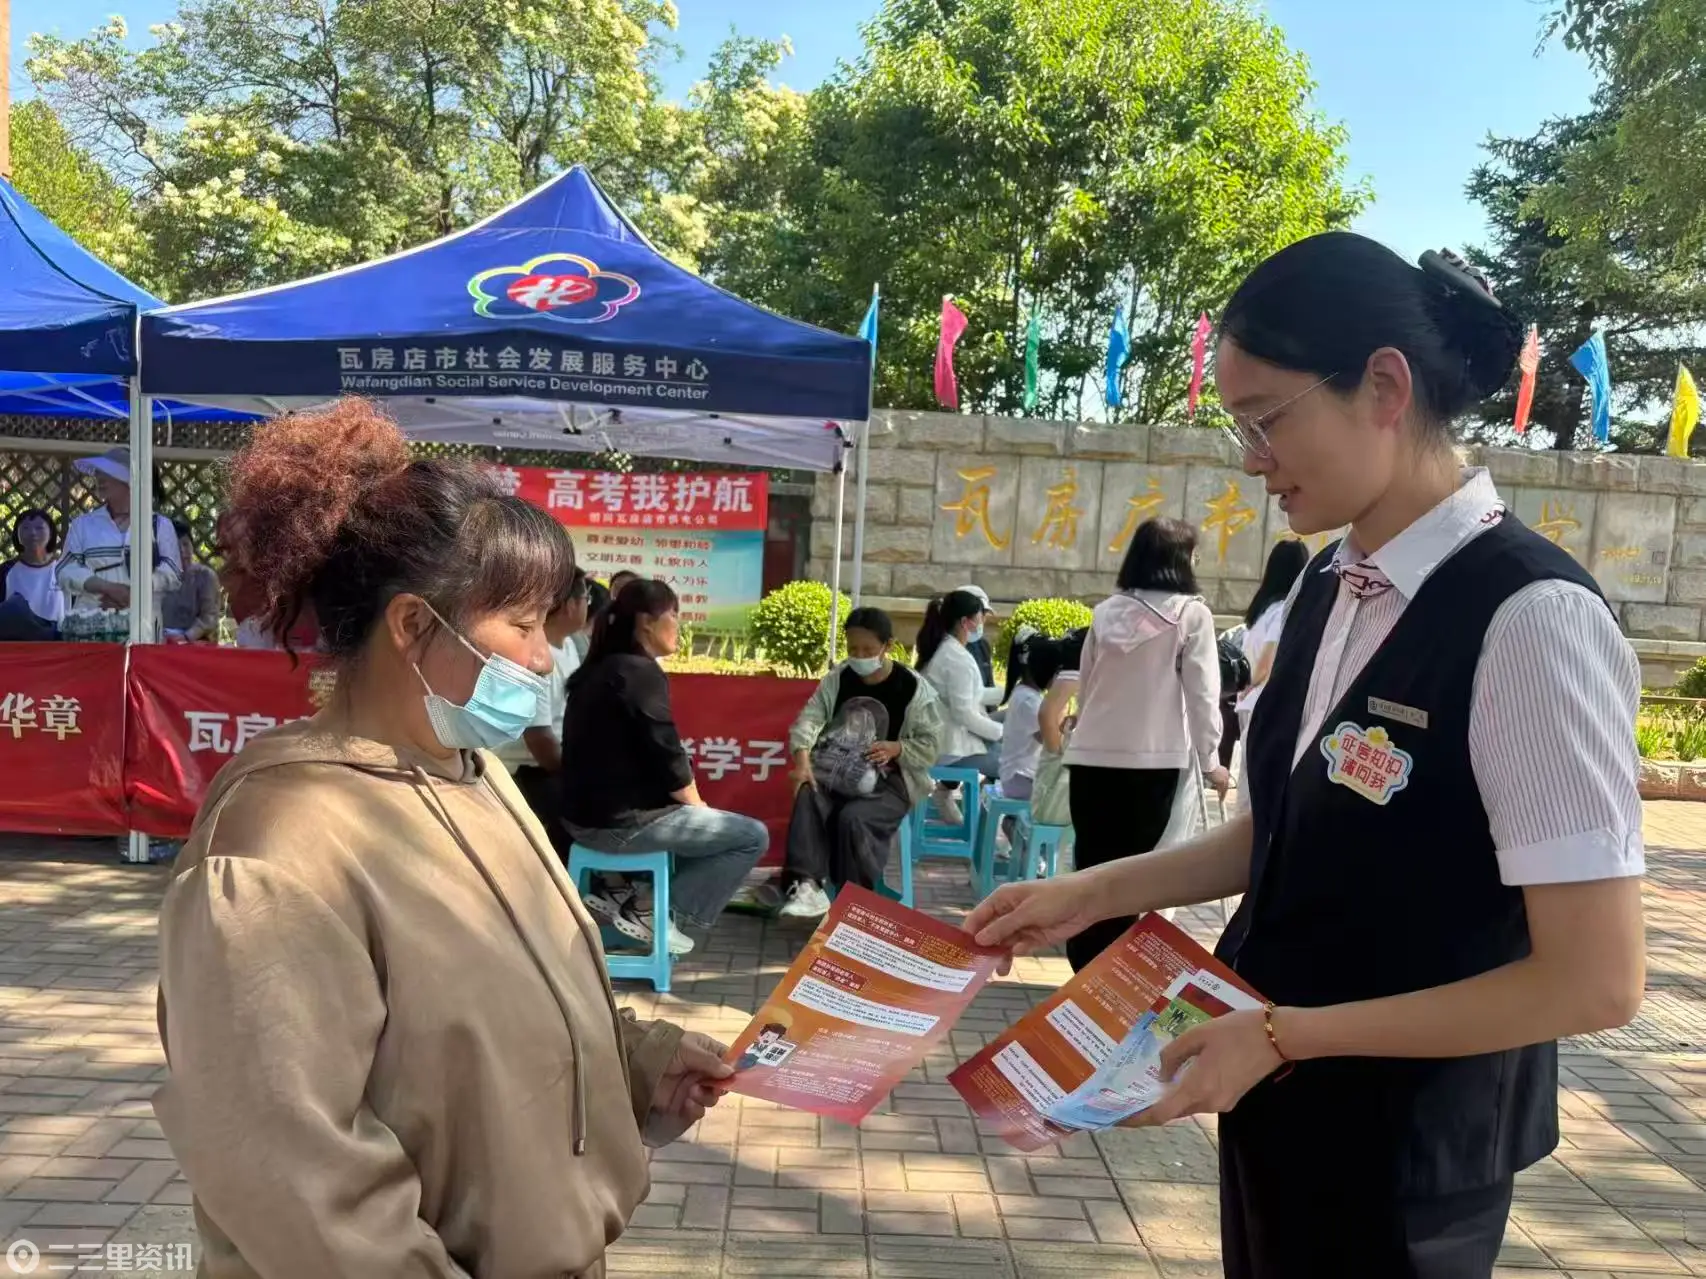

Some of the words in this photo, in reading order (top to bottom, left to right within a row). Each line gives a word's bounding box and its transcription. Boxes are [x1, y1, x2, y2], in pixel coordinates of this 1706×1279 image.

[336, 346, 710, 382] 瓦房店市社会发展服务中心
[340, 375, 432, 391] Wafangdian
[435, 374, 484, 389] Social
[487, 375, 546, 391] Service
[549, 376, 654, 398] Development
[655, 384, 709, 401] Center
[546, 470, 753, 513] 高考我护航
[0, 692, 82, 742] 华章
[183, 709, 310, 754] 瓦房
